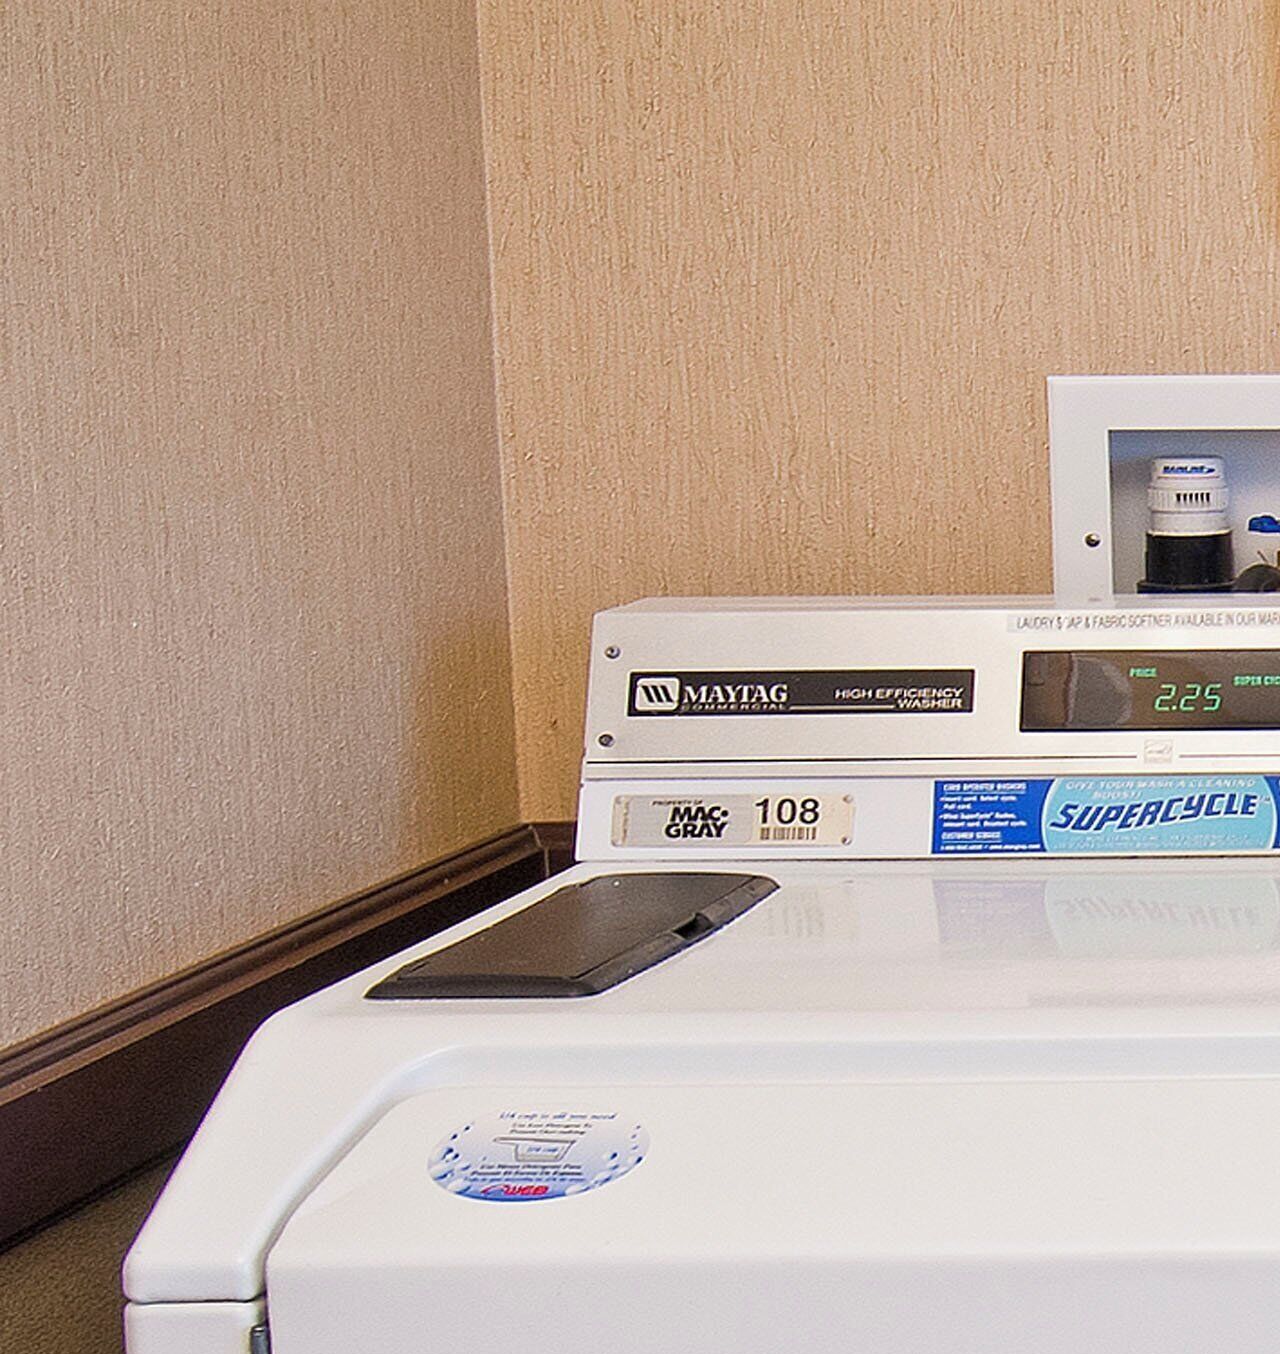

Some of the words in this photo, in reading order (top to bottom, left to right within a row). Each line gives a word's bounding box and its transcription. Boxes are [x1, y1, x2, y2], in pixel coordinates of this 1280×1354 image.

[1085, 616, 1091, 629] &
[1093, 615, 1126, 628] FABRIC
[1128, 614, 1172, 627] SOFTNER
[1174, 613, 1223, 627] AVAILABLE
[1225, 613, 1235, 626] IN
[1236, 613, 1257, 625] OUR
[1233, 676, 1263, 687] SUPER
[683, 684, 789, 704] MAYTAG
[834, 687, 878, 700] HIGH
[878, 686, 965, 699] EFFICIENCY
[1153, 683, 1223, 712] 2.25
[681, 703, 790, 712] COMMERCIAL
[897, 698, 964, 710] WASHER
[1066, 780, 1098, 790] GIVE
[1100, 780, 1134, 790] YOUR
[1136, 780, 1174, 790] WASH
[1188, 778, 1257, 789] CLEANING
[755, 797, 821, 825] 108
[664, 822, 728, 839] GRAY
